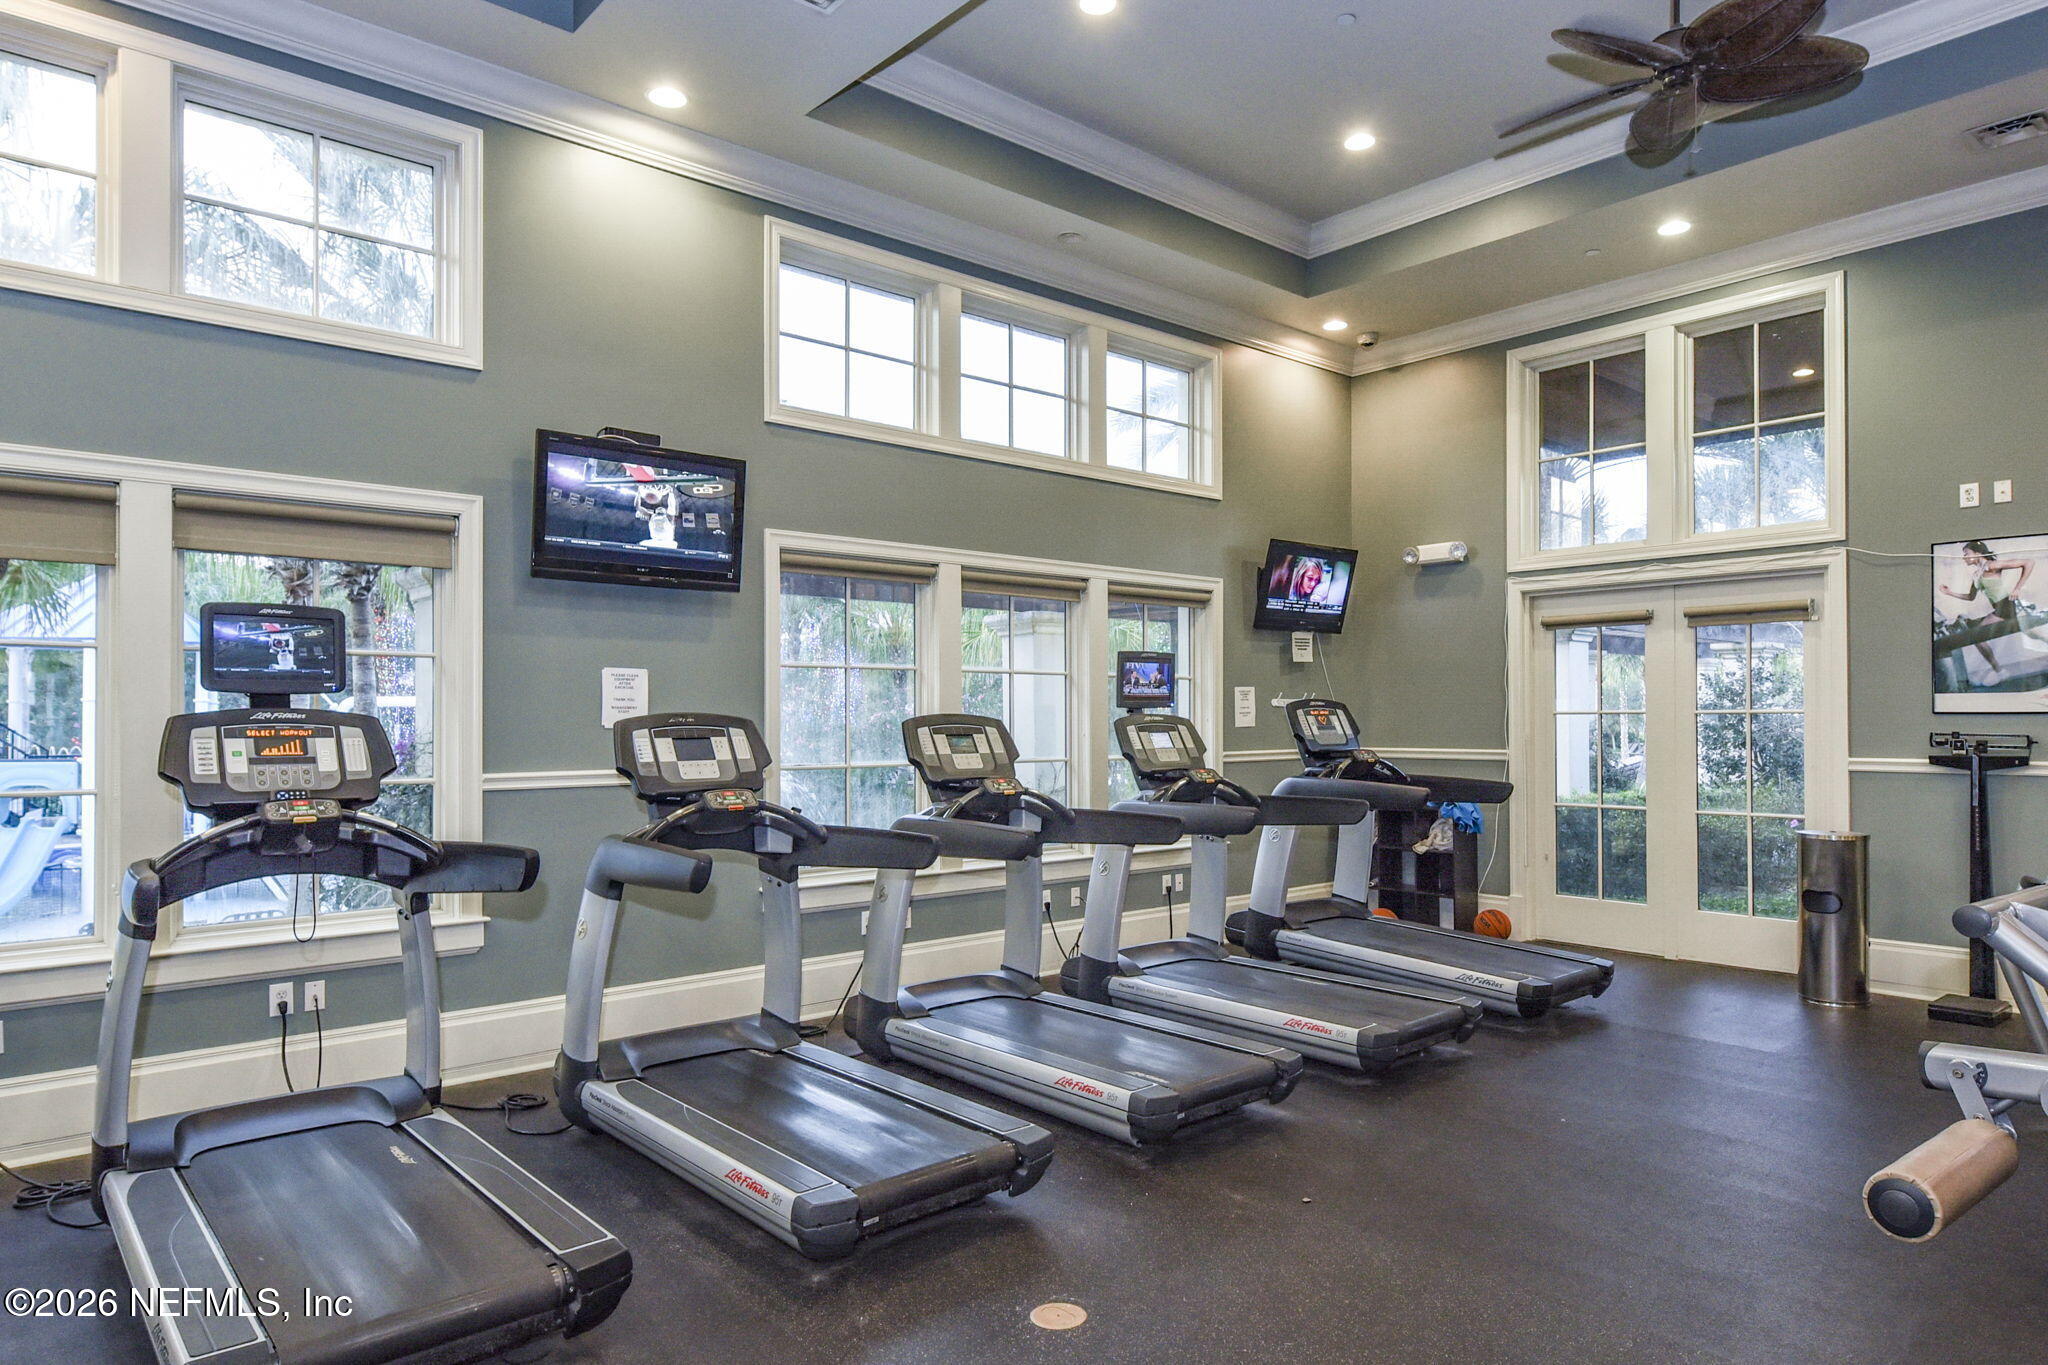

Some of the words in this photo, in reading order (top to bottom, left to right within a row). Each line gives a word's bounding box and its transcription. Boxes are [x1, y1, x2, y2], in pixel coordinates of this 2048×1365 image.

[249, 711, 272, 720] Life
[271, 712, 306, 720] Fitness
[246, 729, 276, 737] SELECT
[279, 729, 313, 737] WORKOUT
[1455, 973, 1474, 983] Life
[1472, 976, 1504, 989] Fitness
[1282, 1018, 1302, 1029] Life
[1300, 1022, 1335, 1035] Fitness
[1054, 1076, 1074, 1088] Life
[1071, 1081, 1104, 1098] Fitness
[724, 1168, 743, 1184] Life
[739, 1175, 770, 1199] Fitness
